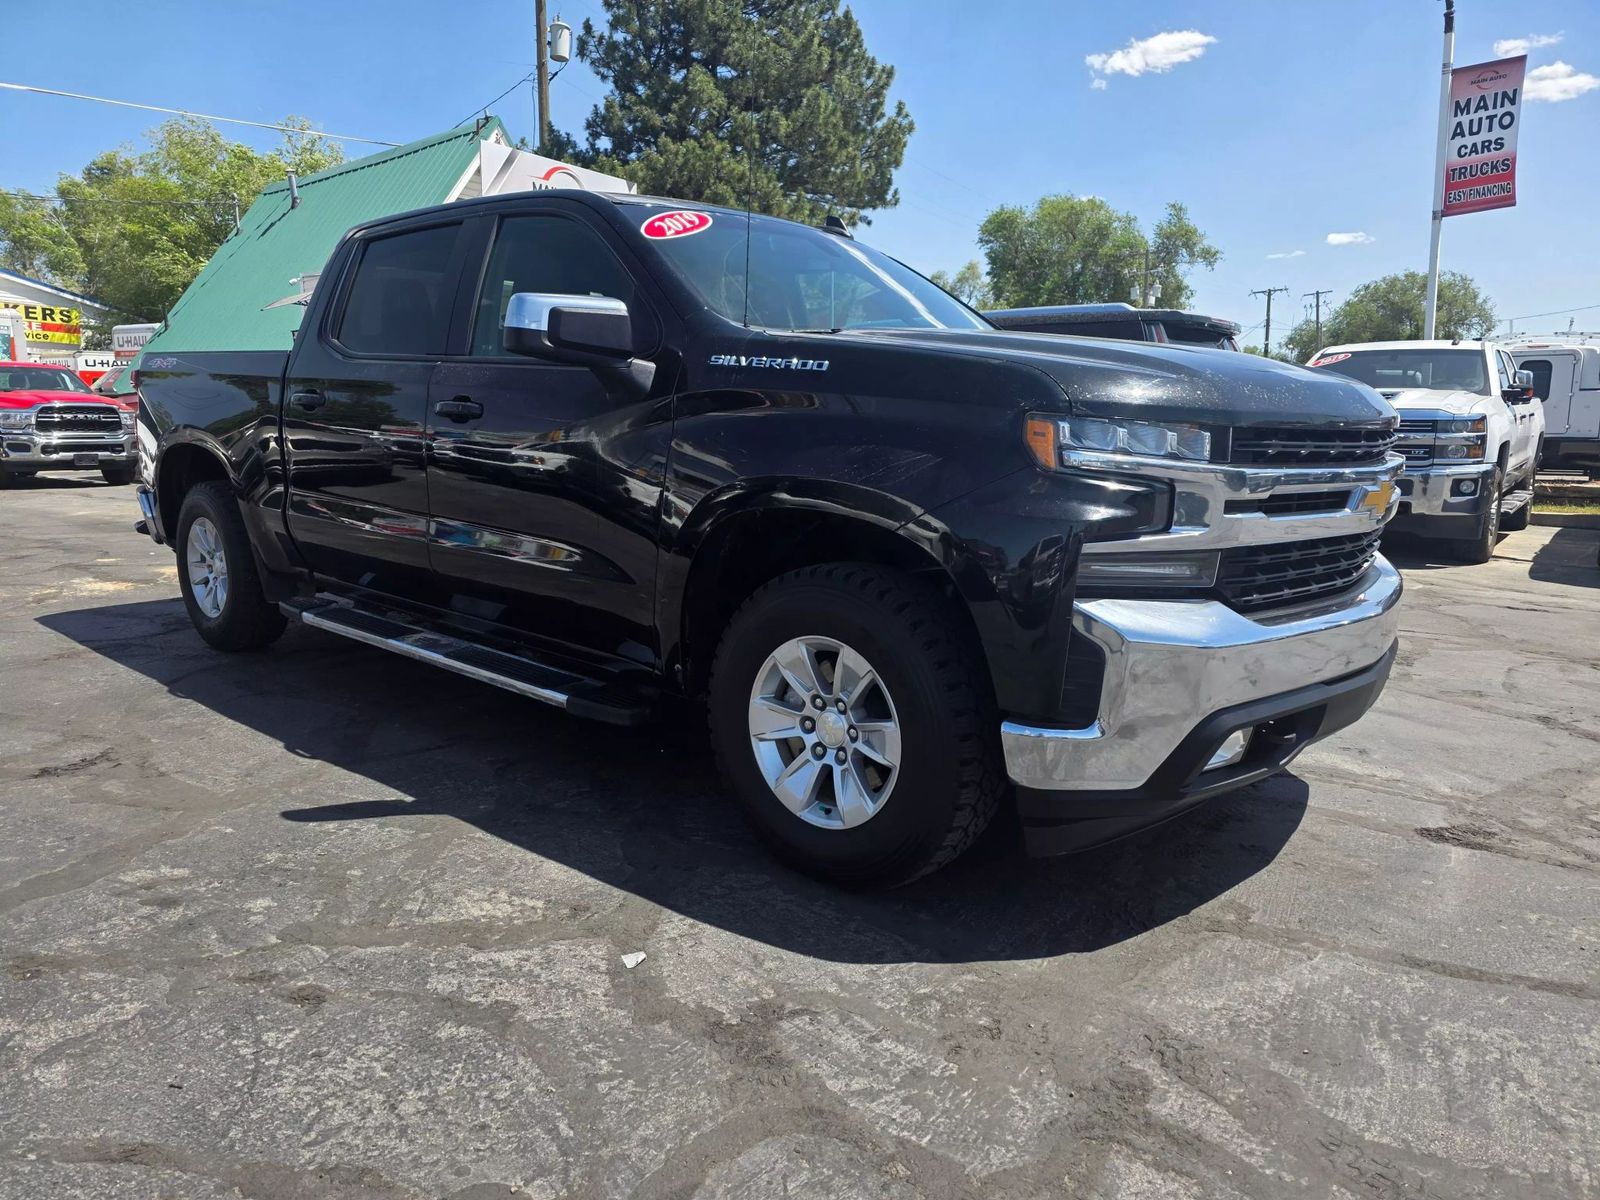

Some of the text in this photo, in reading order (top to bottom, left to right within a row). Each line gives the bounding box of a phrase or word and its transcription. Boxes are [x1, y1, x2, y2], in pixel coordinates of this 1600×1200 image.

[1489, 73, 1507, 81] AUTO
[1453, 88, 1518, 118] MAIN
[1450, 111, 1515, 141] AUTO
[1457, 137, 1505, 158] CARS
[1450, 158, 1511, 182] TRUCKS
[1447, 181, 1512, 204] EASY FINANCING
[654, 212, 700, 236] 2019
[4, 303, 73, 324] ERS
[85, 359, 131, 368] U-HAU
[709, 355, 830, 371] SILVERADO
